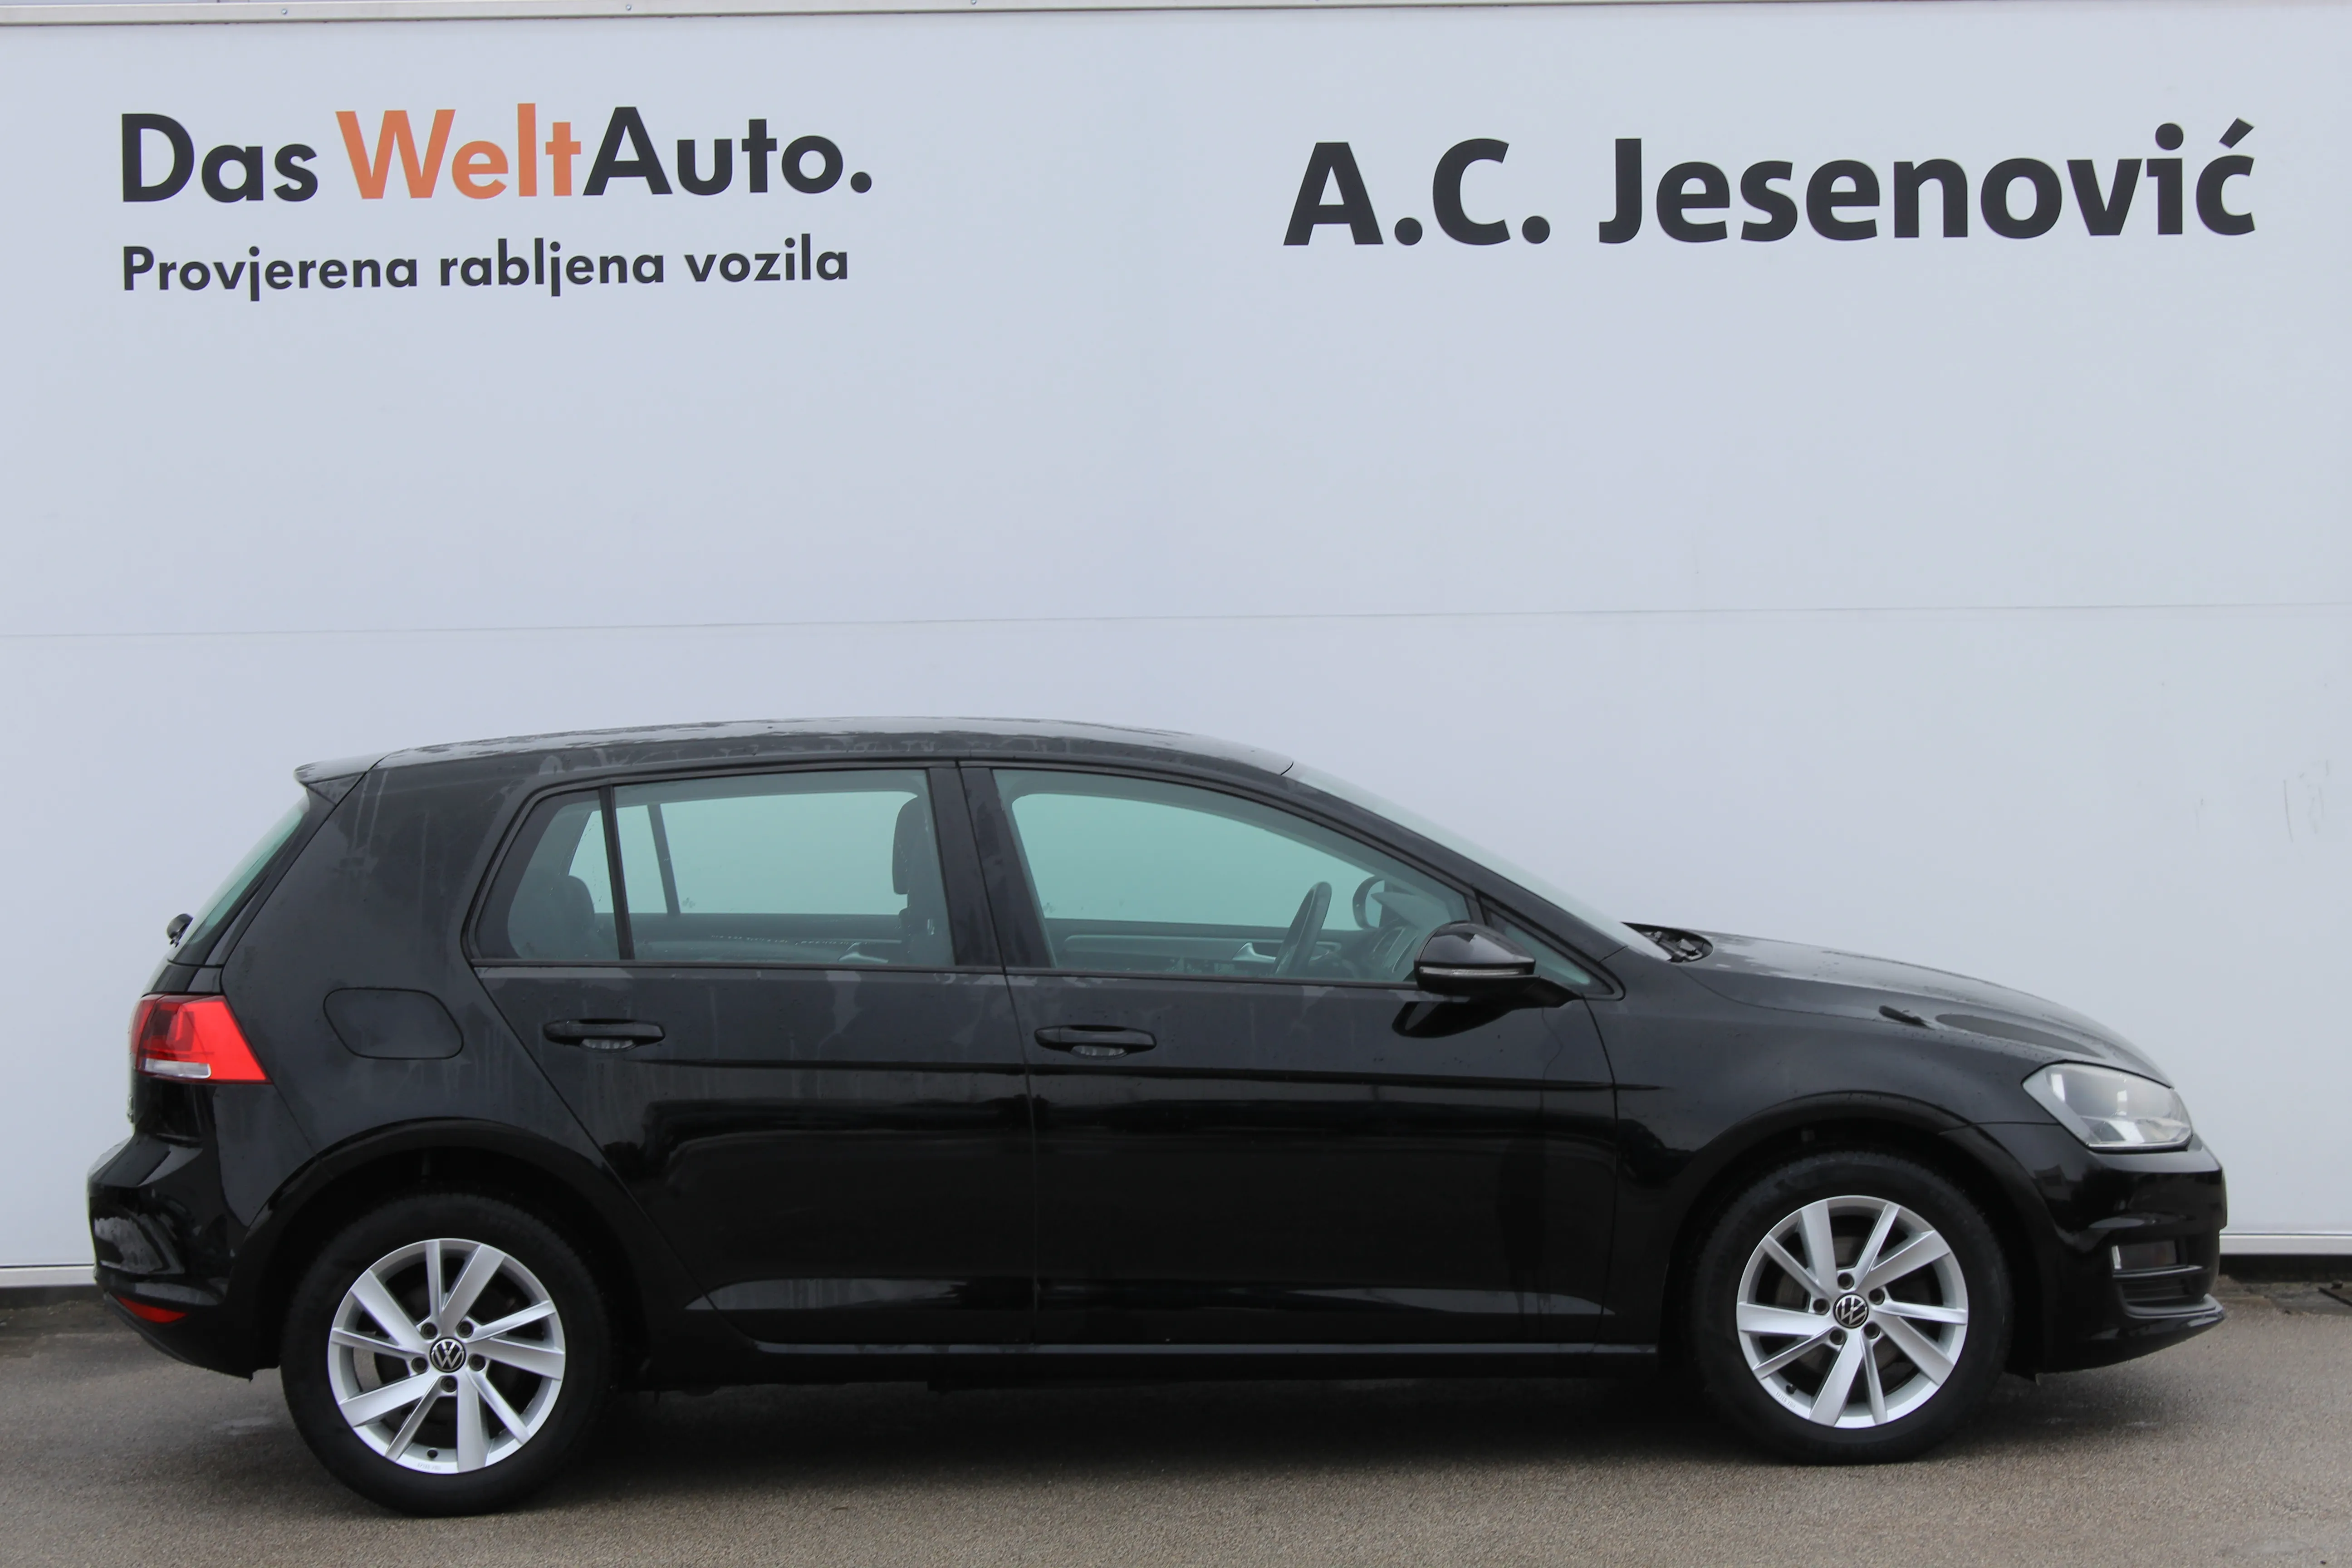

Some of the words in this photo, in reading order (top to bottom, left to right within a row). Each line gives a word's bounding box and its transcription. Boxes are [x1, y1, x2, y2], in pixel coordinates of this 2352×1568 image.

[122, 113, 318, 203] Das
[335, 103, 872, 199] WeltAuto.
[1283, 138, 1550, 246] A.C.
[1599, 118, 2255, 244] Jesenović
[123, 238, 417, 301] Provjerena
[441, 238, 664, 297] rabljena
[684, 233, 848, 282] vozila
